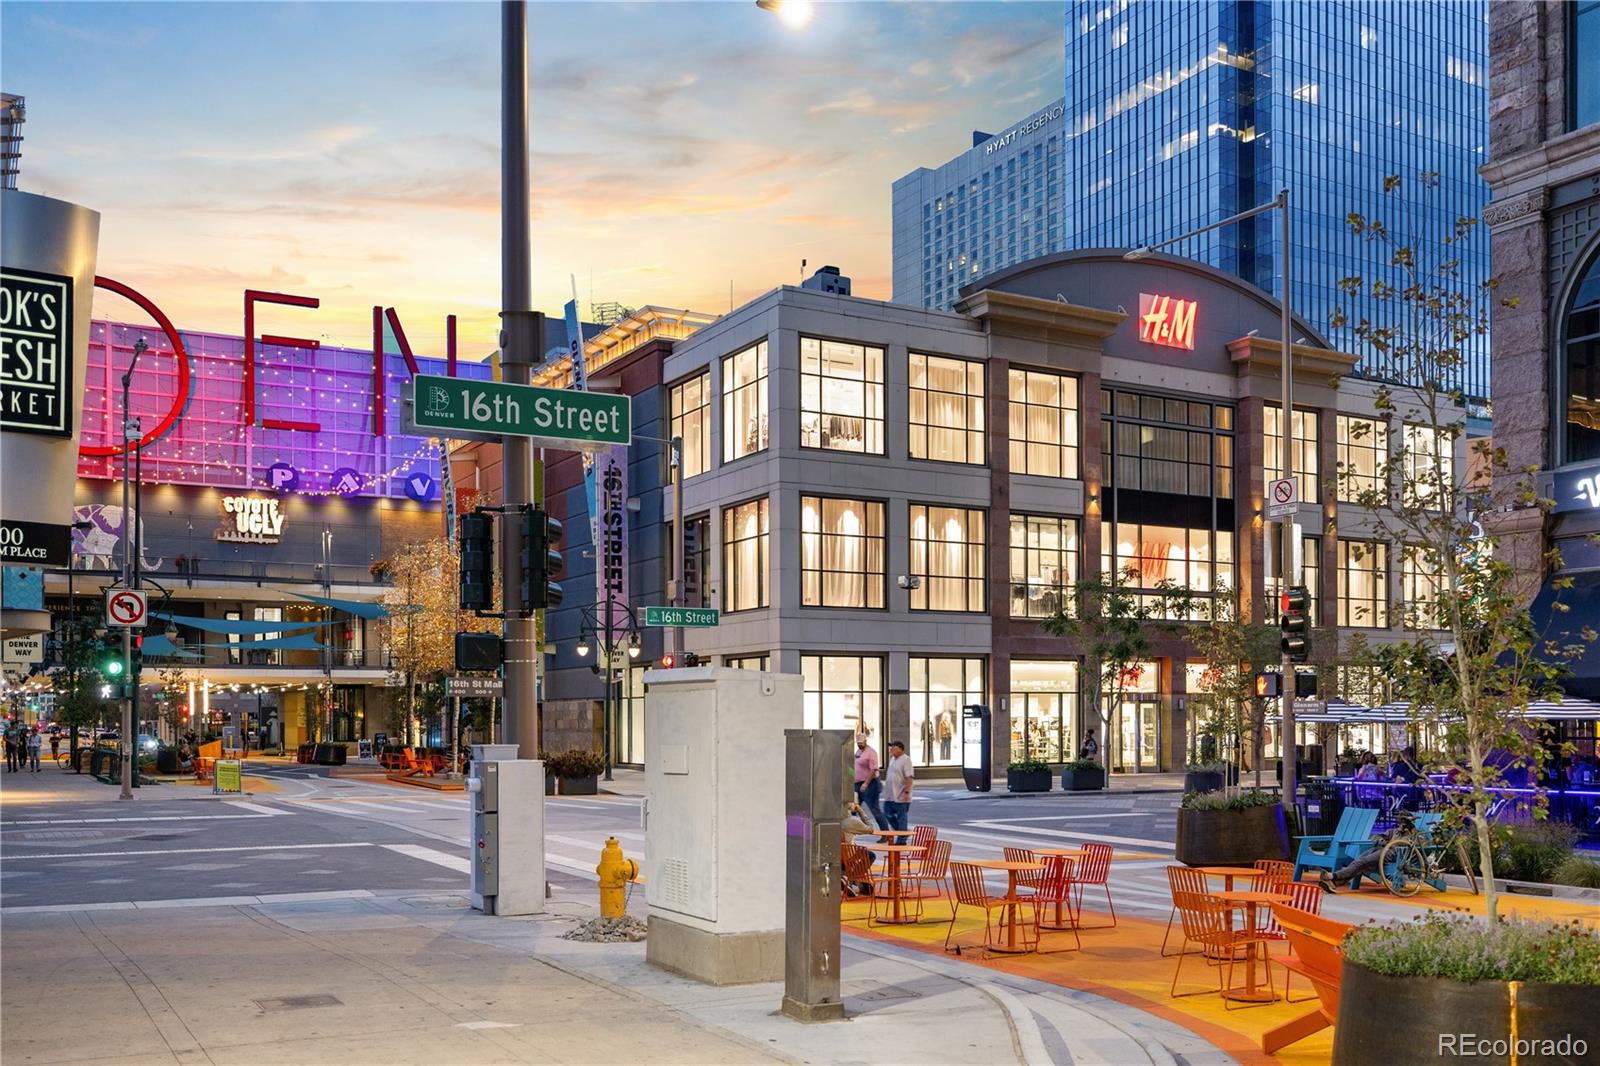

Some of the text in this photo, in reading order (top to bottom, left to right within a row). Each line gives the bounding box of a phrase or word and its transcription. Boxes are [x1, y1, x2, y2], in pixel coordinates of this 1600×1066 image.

[986, 104, 1065, 155] HYATT REGENCY
[1142, 294, 1198, 349] H&M
[424, 410, 455, 418] DENVER
[461, 389, 620, 433] 16th Street
[222, 496, 279, 513] COYOTE
[236, 512, 284, 535] UGLY
[9, 546, 47, 559] PLACE
[661, 611, 716, 624] 16th Street
[8, 640, 38, 649] DENVER
[15, 648, 32, 656] WAY
[448, 680, 503, 688] 16th St Mall
